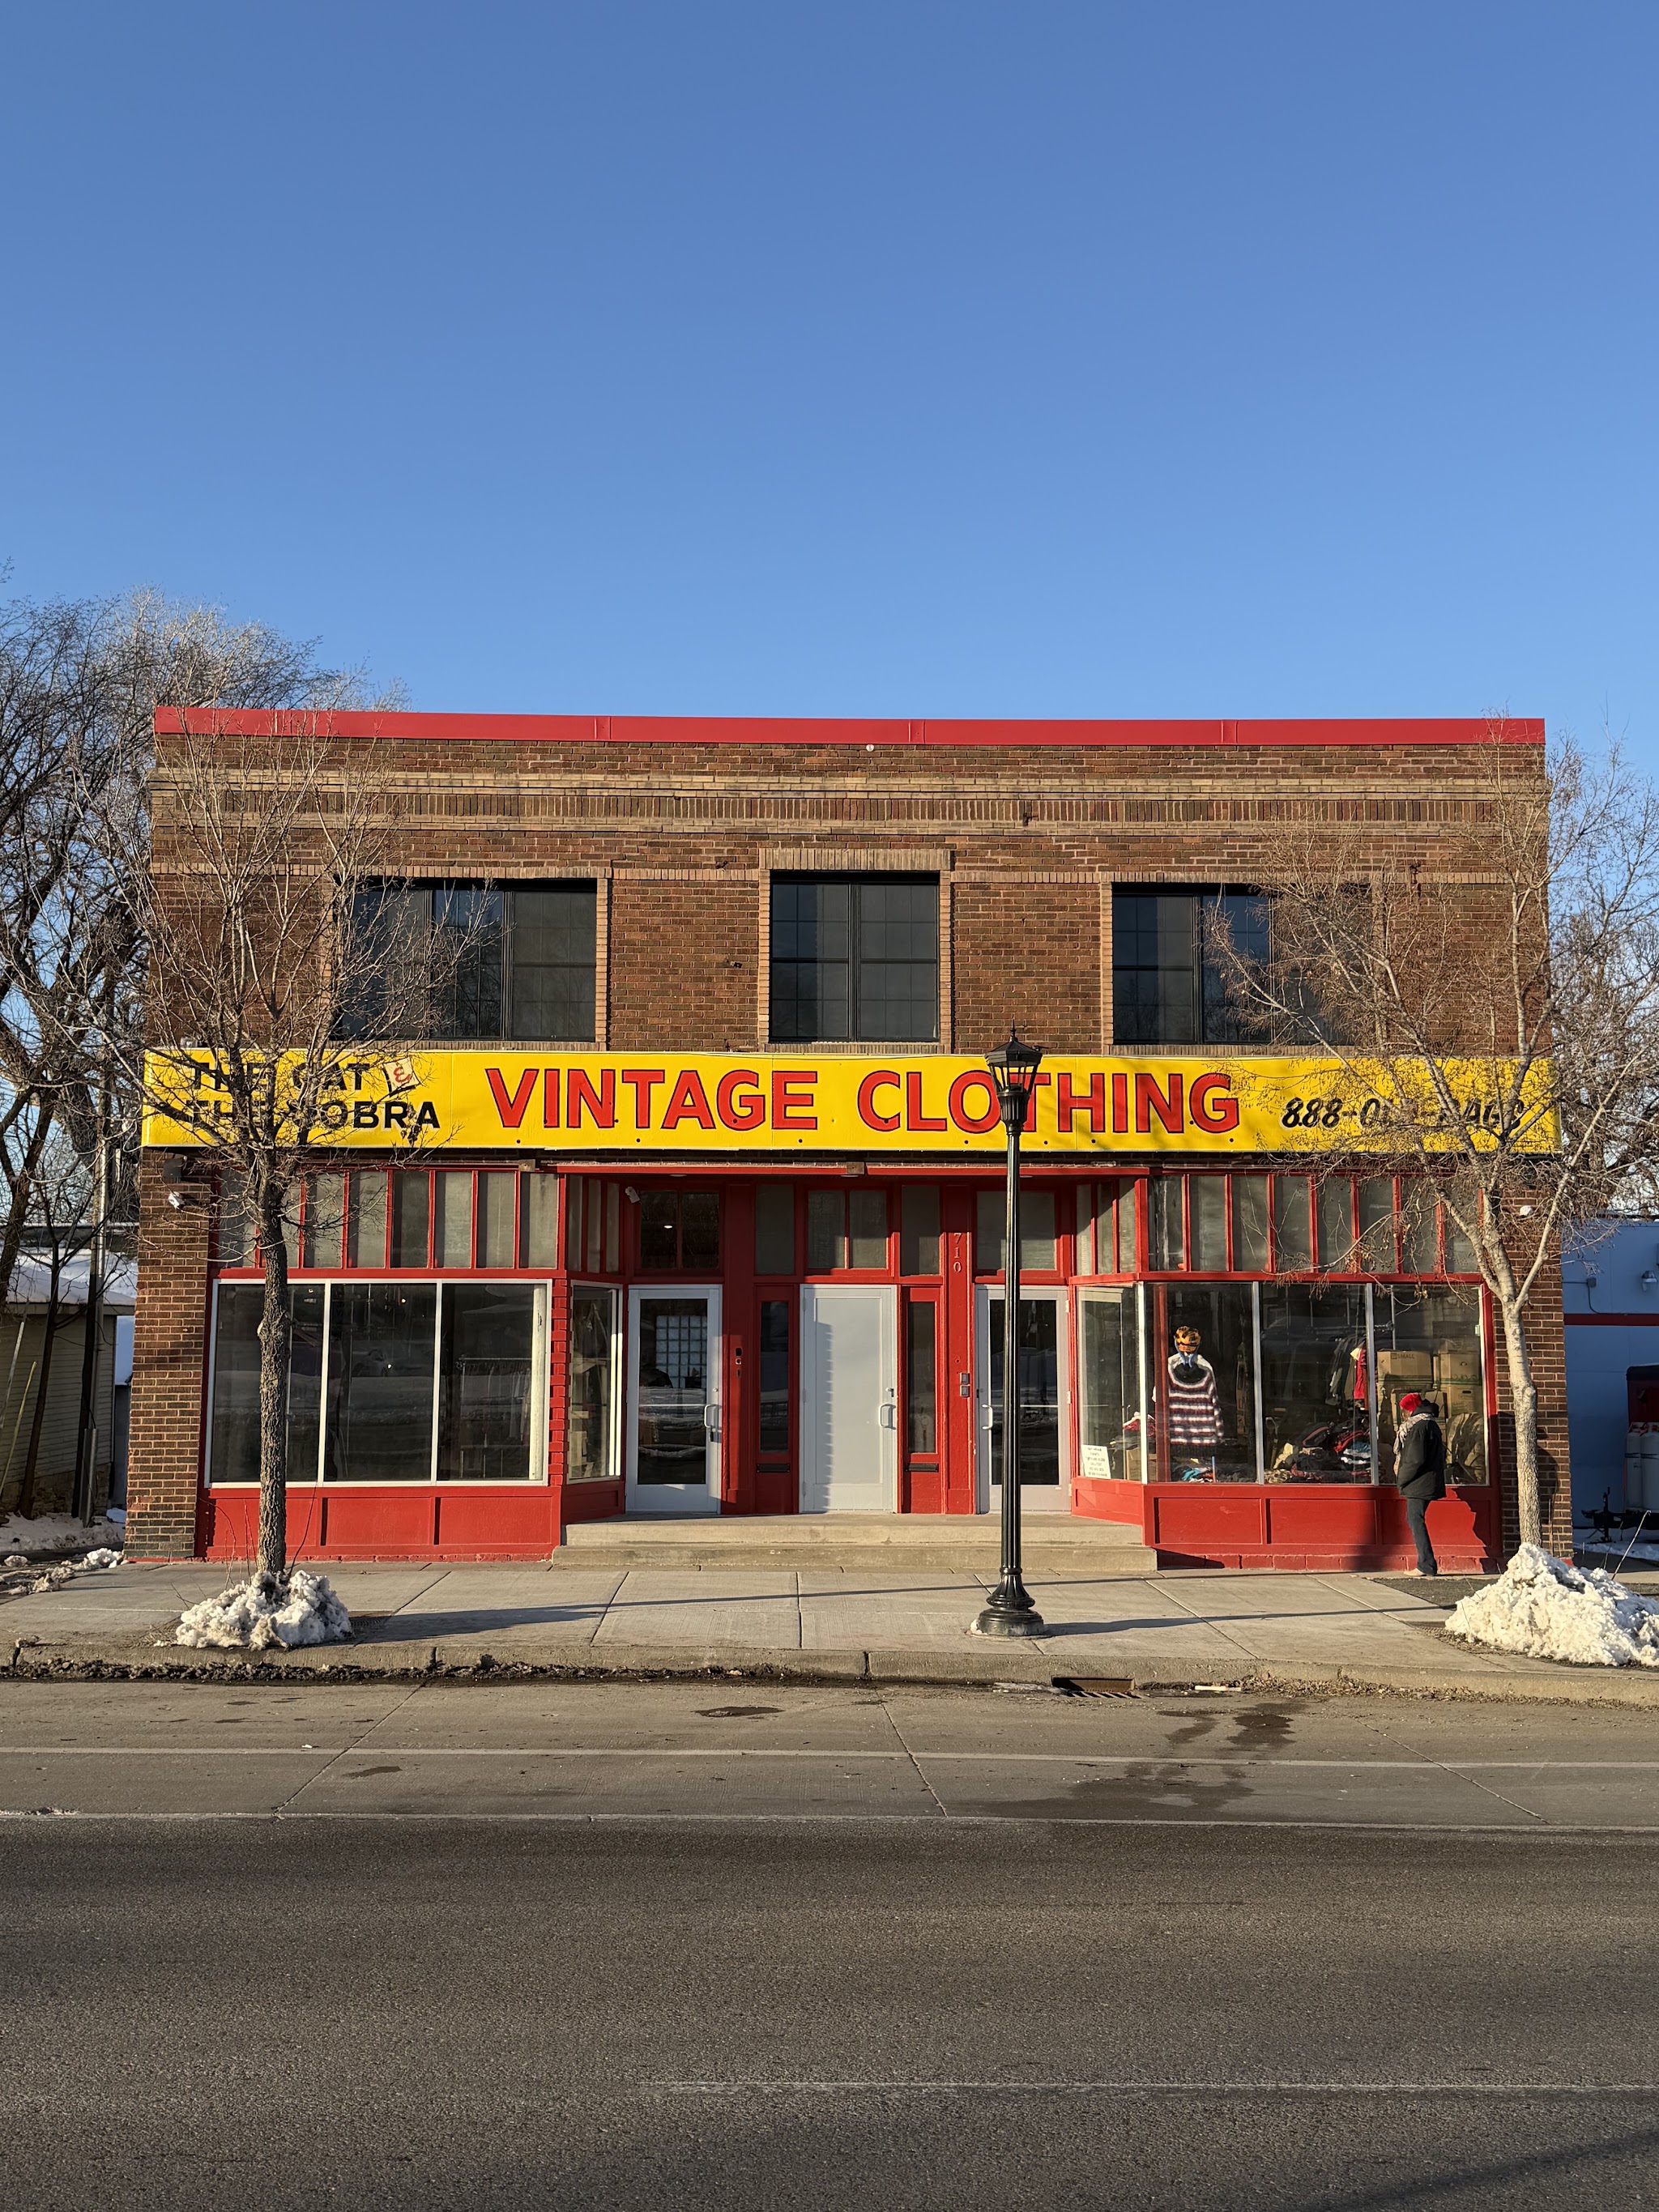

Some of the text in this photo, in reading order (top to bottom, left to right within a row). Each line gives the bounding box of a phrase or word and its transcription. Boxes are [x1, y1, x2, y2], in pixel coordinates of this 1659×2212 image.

[292, 1062, 369, 1090] CAT
[485, 1068, 1240, 1134] VINTAGE CLOTHING
[953, 1232, 962, 1273] 710
